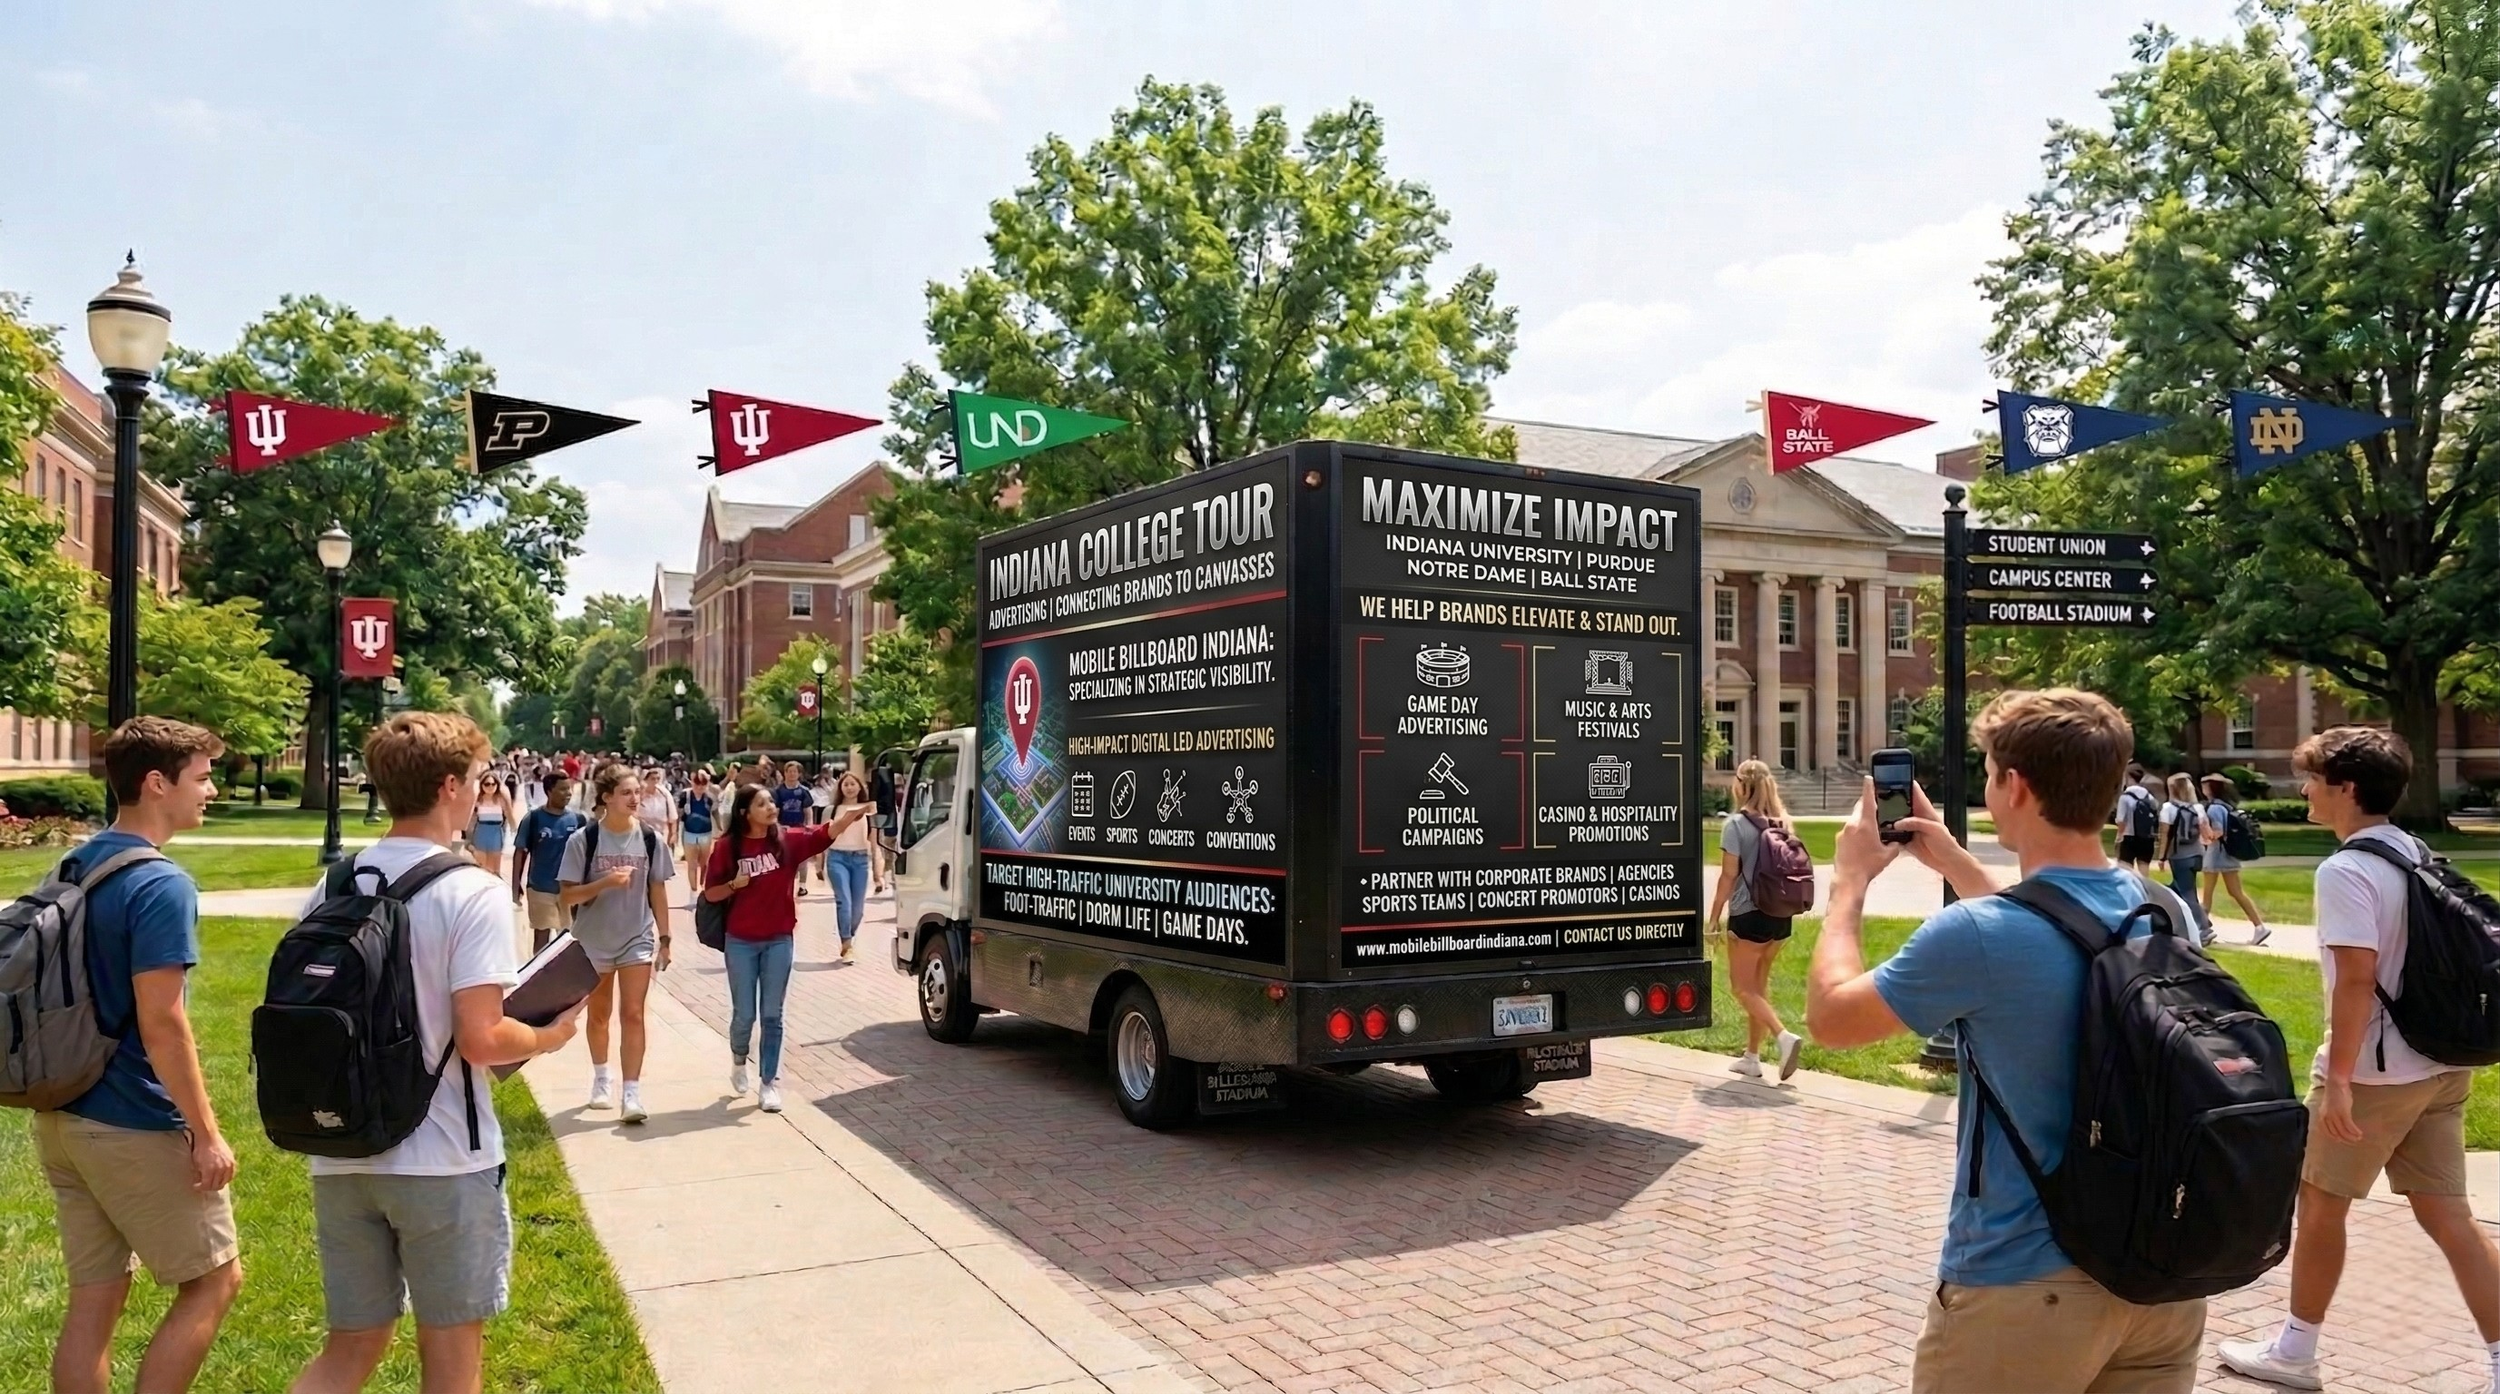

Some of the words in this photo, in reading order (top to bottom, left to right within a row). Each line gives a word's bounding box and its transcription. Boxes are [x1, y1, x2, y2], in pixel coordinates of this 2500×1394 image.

[485, 410, 550, 452] P
[1786, 428, 1829, 440] BALL
[1782, 440, 1834, 454] STATE
[1362, 476, 1542, 539] MAXIMIZE
[1554, 497, 1678, 552] IMPACT
[989, 538, 1071, 602] INDIANA
[1078, 506, 1185, 582] COLLEGE
[1192, 482, 1274, 554] TOUR
[1988, 535, 2055, 554] STUDENT
[2059, 538, 2106, 555] UNION
[1386, 534, 1465, 557] INDIANA
[1470, 542, 1573, 566] UNIVERSITY
[1587, 553, 1655, 574] PURDUE
[1407, 559, 1469, 579] NOTRE
[1474, 564, 1526, 584] DAME
[1540, 570, 1583, 589] BALL
[1587, 573, 1637, 593] STATE
[1989, 569, 2051, 587] CAMPUS
[2054, 570, 2112, 588] CENTER
[989, 600, 1047, 630] ADVERTISING
[1055, 587, 1121, 618] CONNECTING
[1124, 573, 1172, 605] BRANDS
[1175, 569, 1191, 594] TO
[1195, 551, 1275, 590] CANVASSES
[1360, 596, 1386, 618] WE
[1391, 598, 1434, 620] HELP
[1439, 601, 1508, 625] BRANDS
[1512, 606, 1576, 629] ELEVATE
[1580, 610, 1592, 631] &
[1596, 612, 1644, 634] STAND
[1649, 614, 1681, 636] OUT.
[1989, 603, 2064, 621] FOOTBALL
[2067, 604, 2132, 622] STADIUM
[1069, 645, 1116, 677] MOBILE
[1119, 635, 1198, 671] BILLBOARD
[1202, 624, 1274, 660] INDIANA:
[1069, 676, 1132, 702] SPECIALIZING
[1134, 675, 1146, 695] IN
[1148, 668, 1207, 694] STRATEGIC
[1210, 661, 1275, 688] VISIBILITY.
[1407, 694, 1448, 714] GAME
[1451, 696, 1478, 714] DAY
[1565, 700, 1606, 718] MUSIC
[1609, 701, 1618, 718] &
[1620, 702, 1652, 719] ARTS
[1397, 716, 1488, 736] ADVERTISING
[1578, 721, 1640, 739] FESTIVALS
[1069, 734, 1130, 756] HIGH-IMPACT
[1131, 732, 1171, 754] DIGITAL
[1173, 731, 1193, 752] LED
[1195, 727, 1275, 752] ADVERTISING
[1407, 807, 1479, 825] POLITICAL
[1538, 806, 1586, 823] CASINO
[1589, 806, 1598, 822] &
[1601, 805, 1678, 822] HOSPITALITY
[1068, 825, 1096, 842] EVENTS
[1106, 827, 1138, 844] SPORTS
[1148, 829, 1196, 847] CONCERTS
[1206, 831, 1276, 852] CONVENTIONS
[1402, 828, 1484, 847] CAMPAIGNS
[1568, 825, 1650, 843] PROMOTIONS
[1371, 872, 1433, 890] PARTNER
[1437, 870, 1472, 888] WITH
[1475, 868, 1552, 887] CORPORATE
[1556, 866, 1607, 884] BRANDS
[1617, 864, 1675, 882] AGENCIES
[985, 862, 1023, 886] TARGET
[1026, 866, 1102, 897] HIGH-TRAFFIC
[1105, 873, 1182, 905] UNIVERSITY
[1185, 880, 1276, 914] AUDIENCES:
[1362, 895, 1417, 914] SPORTS
[1420, 893, 1466, 912] TEAMS
[1477, 890, 1537, 909] CONCERT
[1541, 887, 1618, 906] PROMOTORS
[1629, 884, 1681, 902] CASINOS
[1004, 891, 1076, 921] FOOT-TRAFFIC
[1086, 901, 1122, 928] DORM
[1125, 906, 1151, 932] LIFE
[1162, 910, 1202, 939] GAME
[1206, 914, 1249, 946] DAYS.
[1356, 932, 1551, 957] www.mobilebillboardindiana.com
[1563, 926, 1615, 945] CONTACT
[1616, 925, 1632, 942] US
[1635, 923, 1685, 941] DIRECTLY
